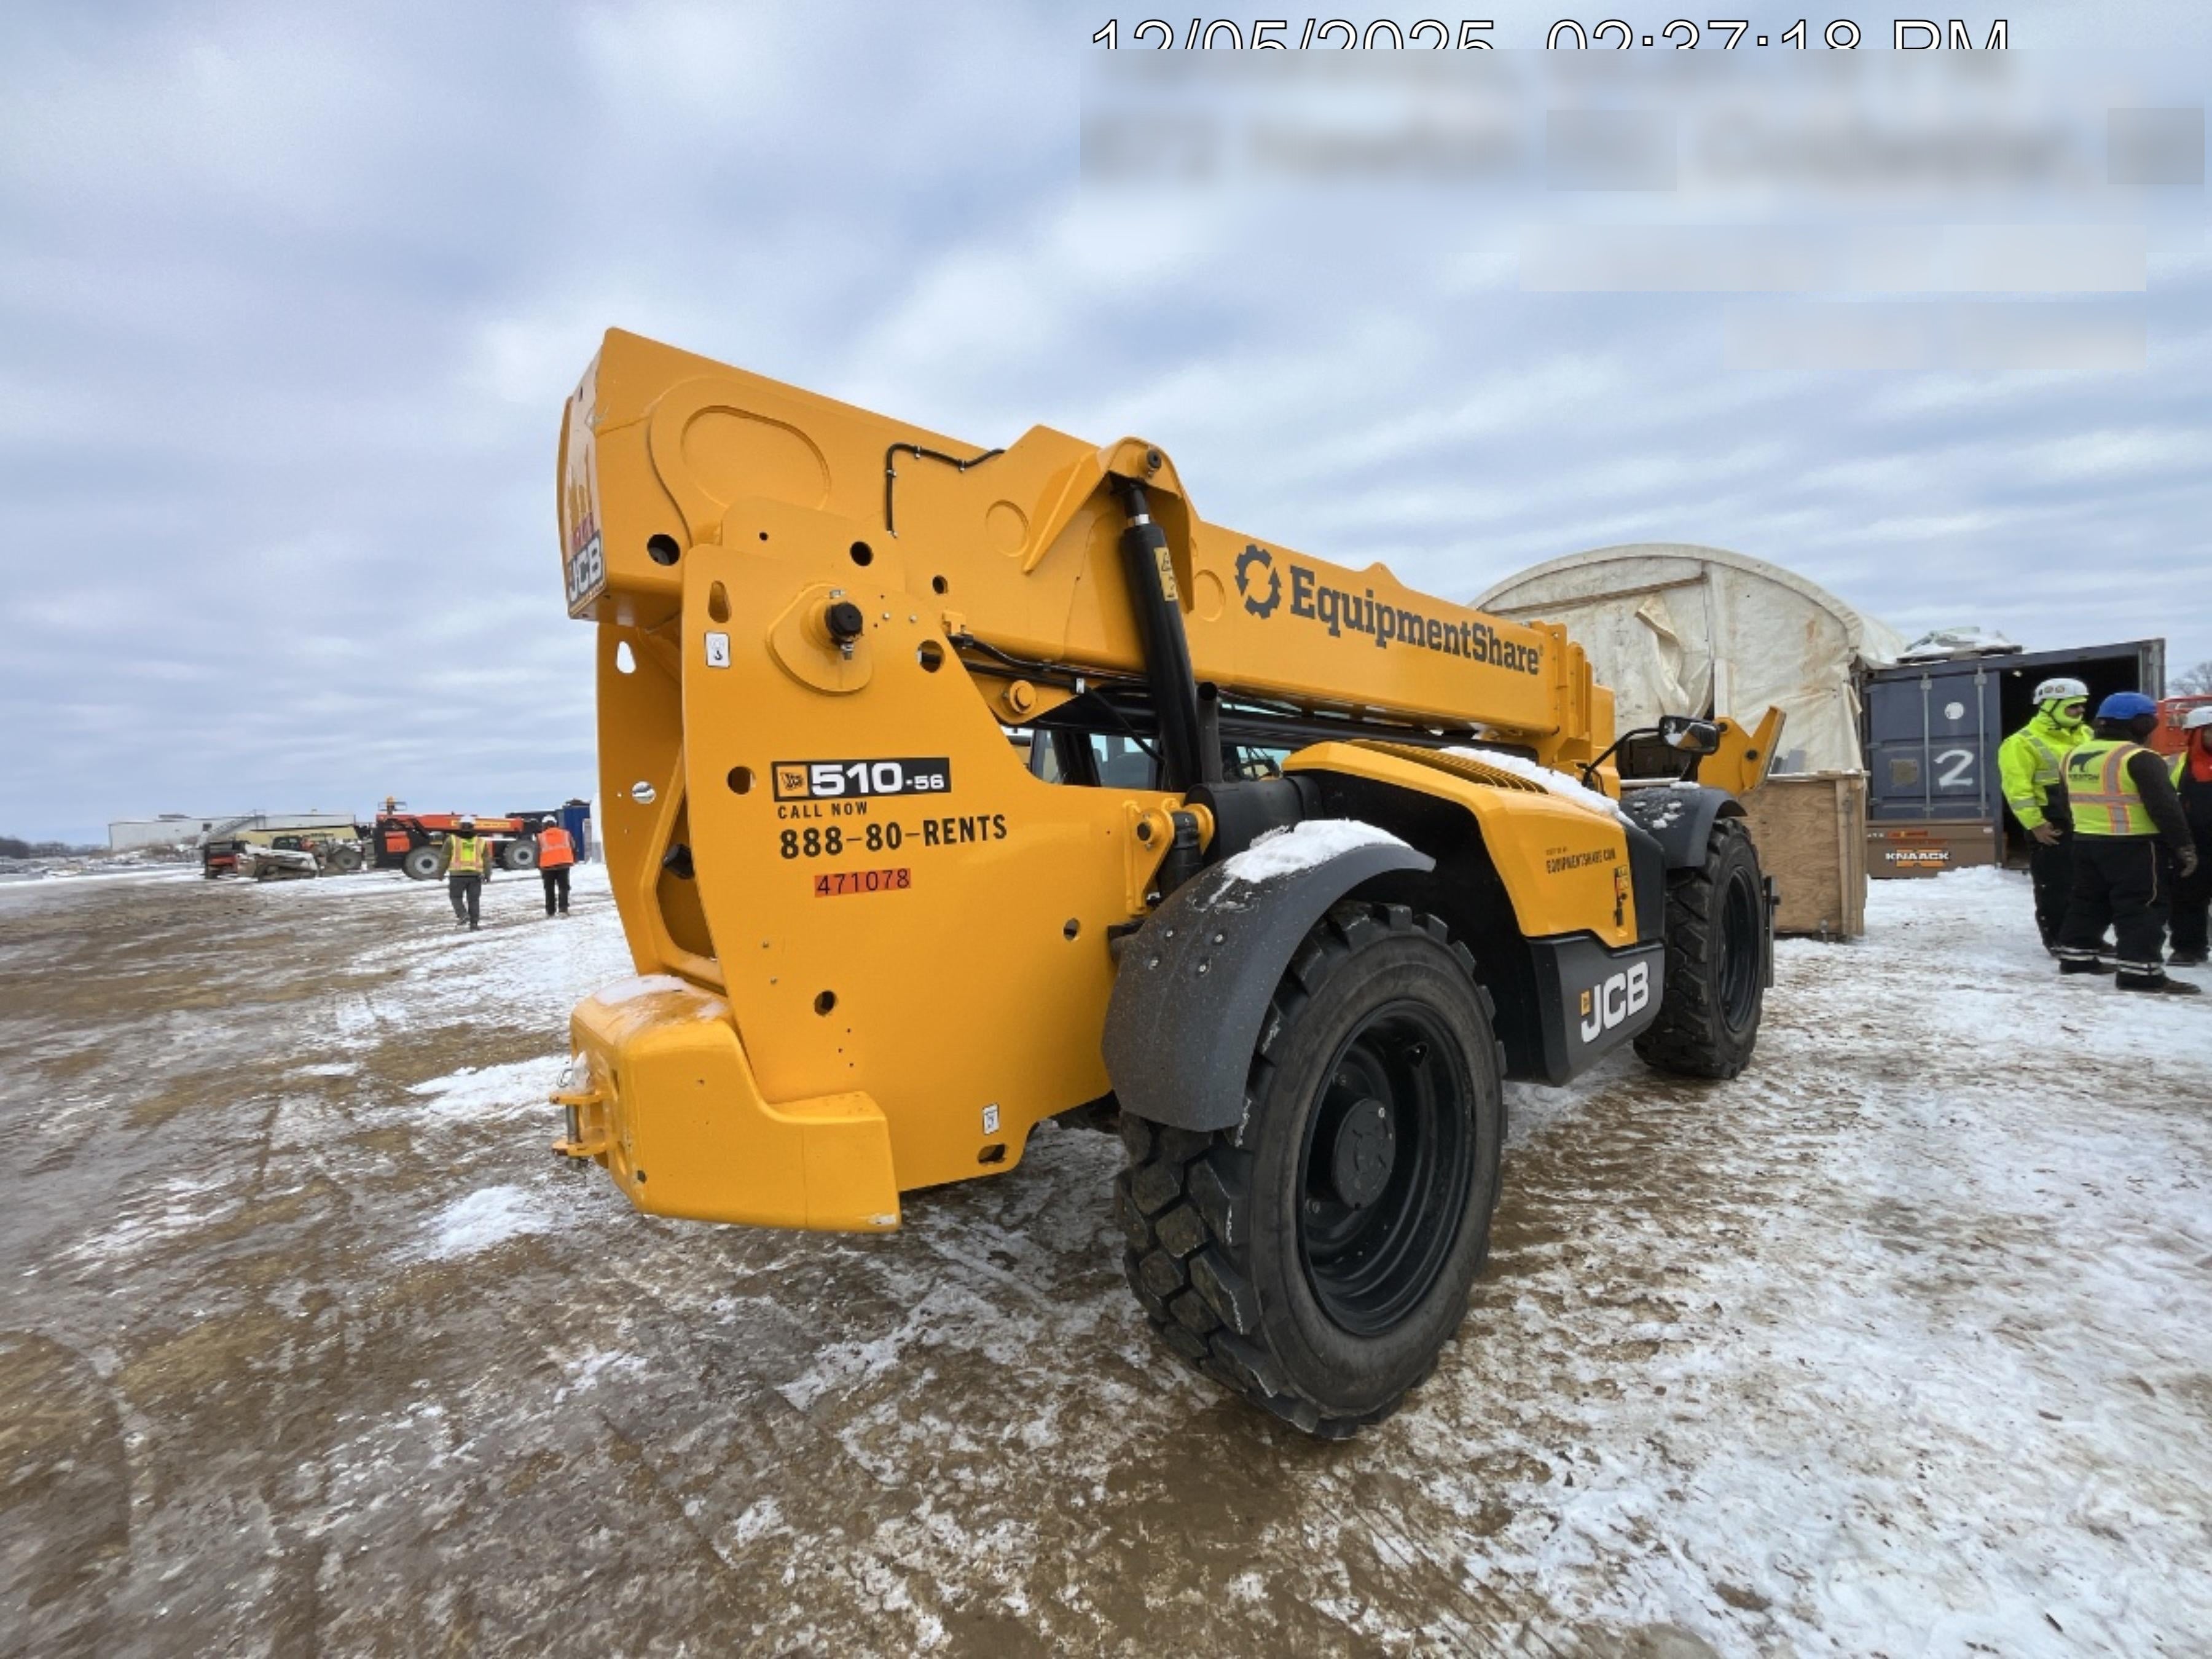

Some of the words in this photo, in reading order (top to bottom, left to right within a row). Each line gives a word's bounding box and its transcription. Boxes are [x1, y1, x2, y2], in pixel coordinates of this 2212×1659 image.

[569, 535, 602, 602] JCB
[1290, 565, 1539, 675] EquipmentShare
[811, 762, 944, 796] 510-56
[1934, 750, 1974, 789] 2
[777, 804, 823, 819] CALL
[831, 802, 868, 816] NOW
[780, 814, 1008, 859] 888-80-RENTS
[1885, 852, 1950, 860] KNAACK
[816, 868, 911, 895] 471078
[1581, 961, 1649, 1043] JCB
